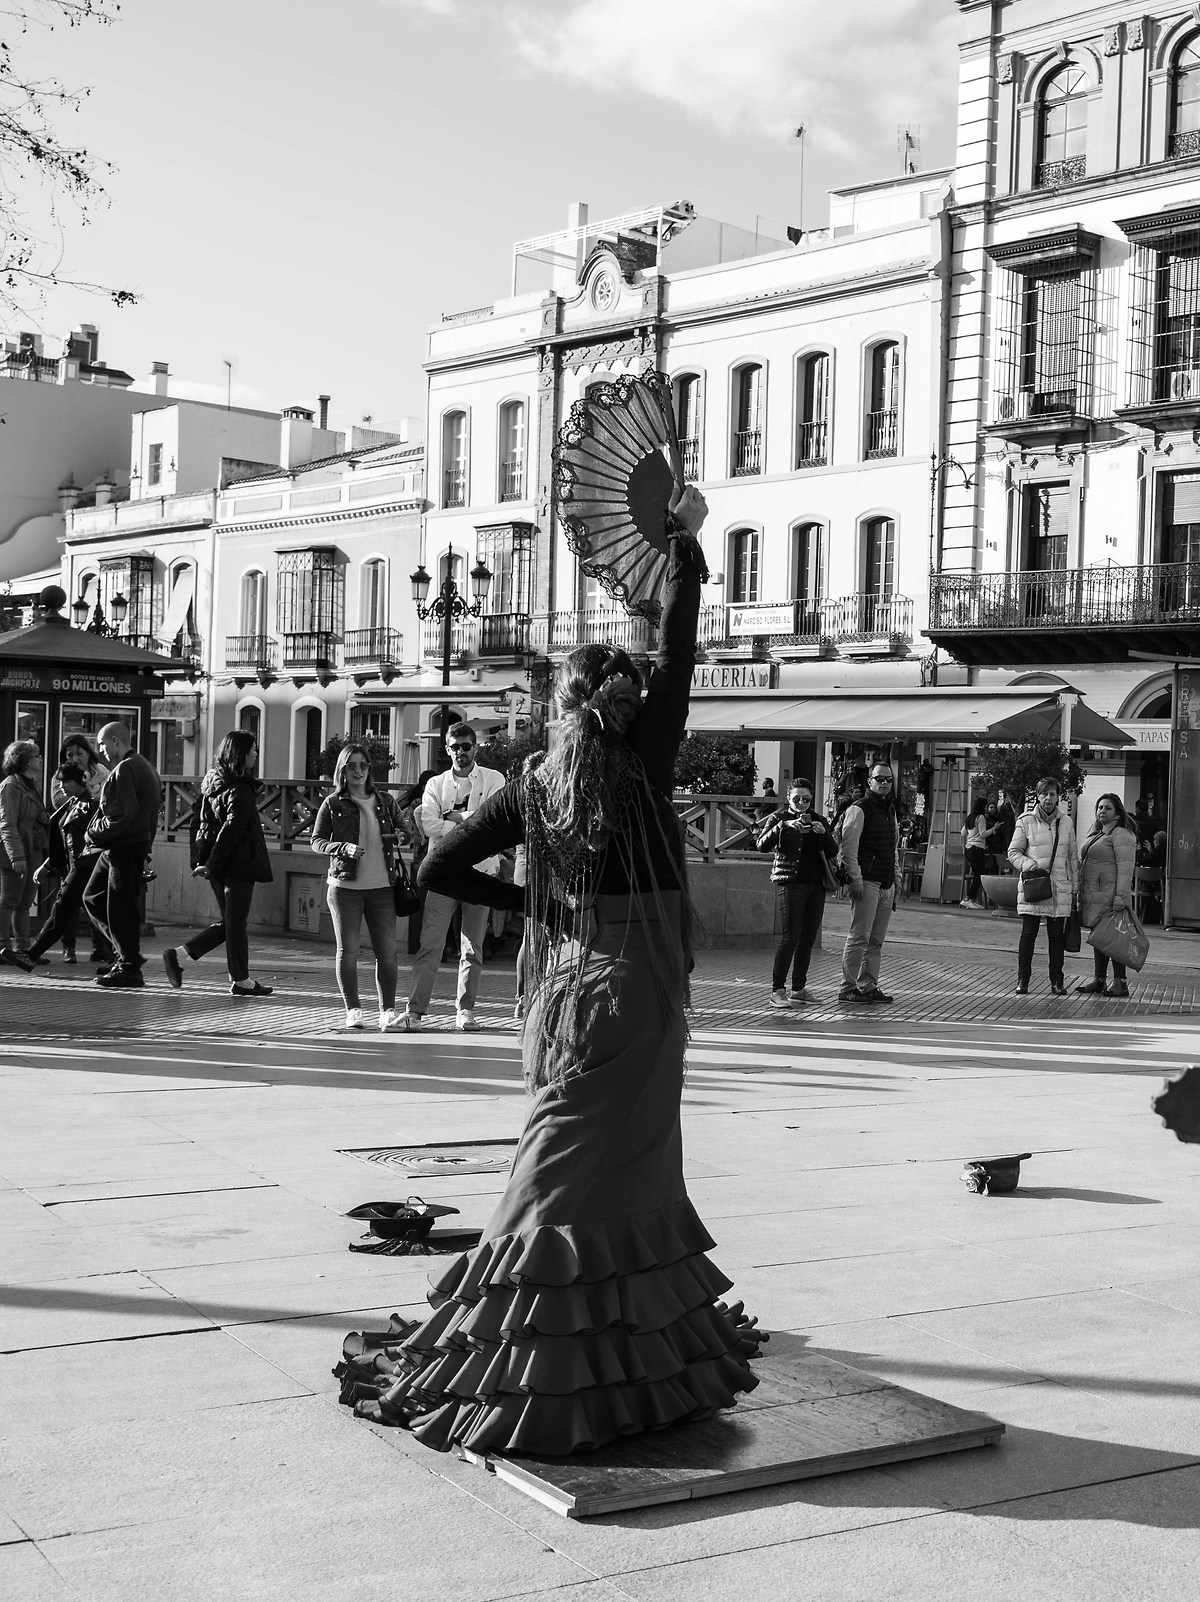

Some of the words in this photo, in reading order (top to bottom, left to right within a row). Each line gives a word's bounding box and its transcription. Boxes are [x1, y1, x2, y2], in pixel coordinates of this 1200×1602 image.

[691, 666, 757, 688] VECERÍA
[52, 679, 70, 690] 90
[72, 680, 131, 694] MILLONES
[1179, 674, 1190, 759] PRENSA
[1140, 731, 1170, 743] TAPAS
